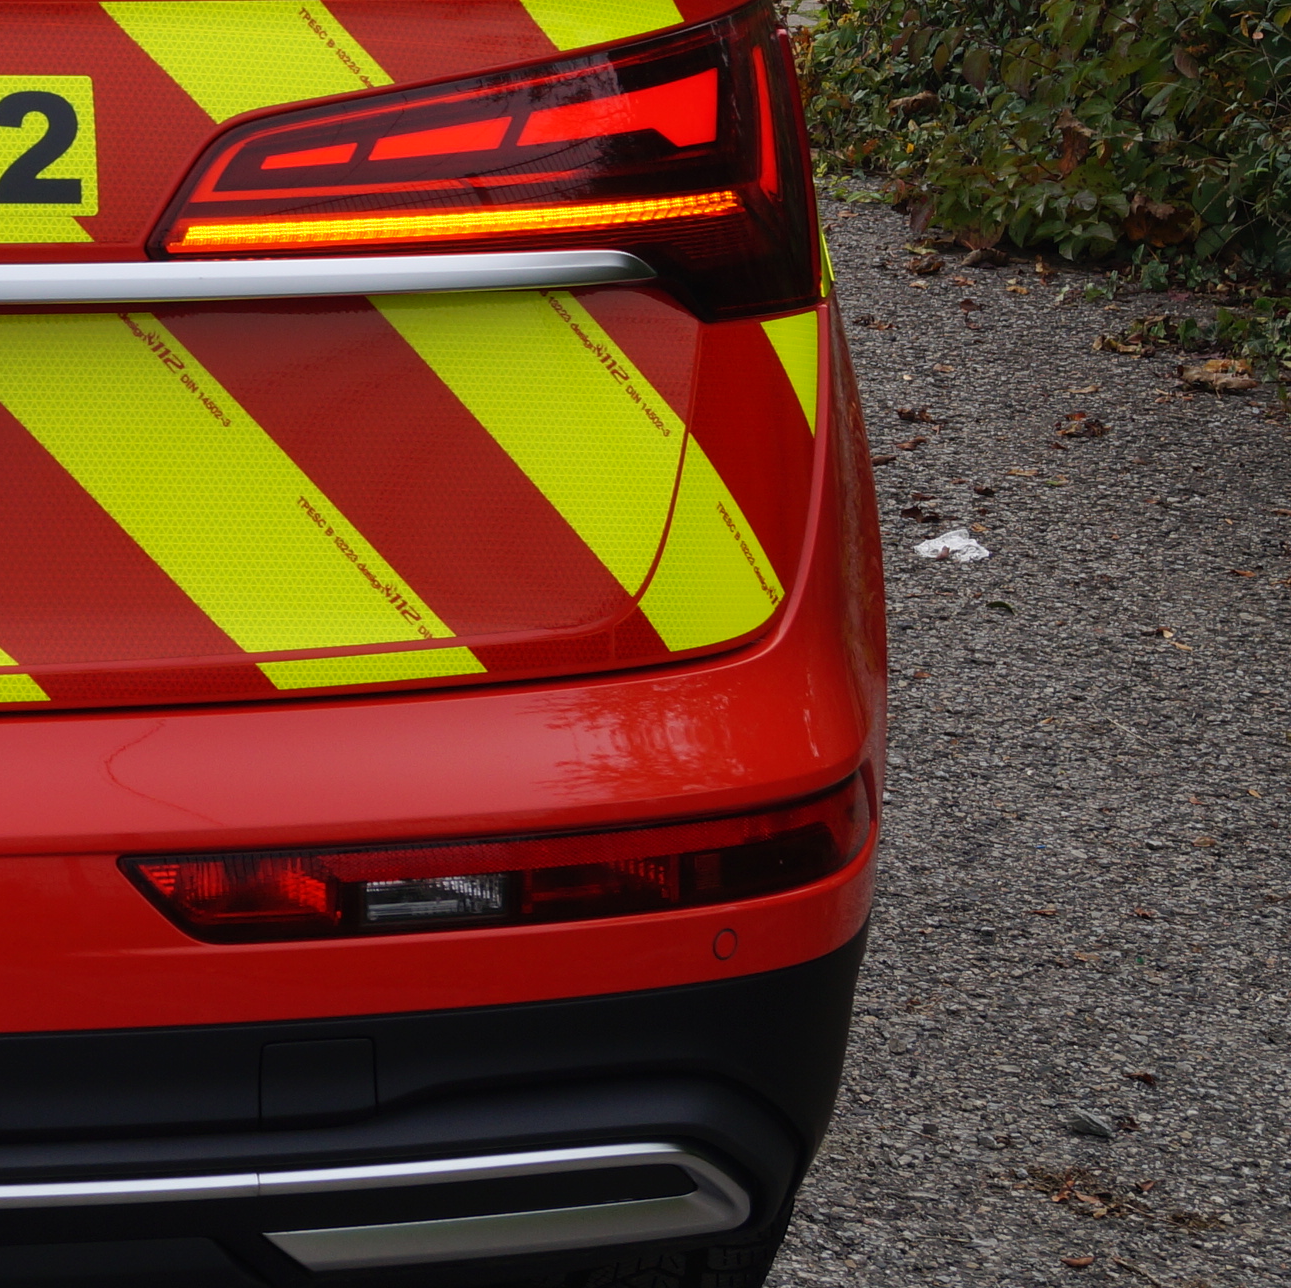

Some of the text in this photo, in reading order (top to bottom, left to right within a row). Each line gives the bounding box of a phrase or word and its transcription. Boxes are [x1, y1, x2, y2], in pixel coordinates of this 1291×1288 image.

[180, 374, 200, 394] DIN
[198, 392, 232, 428] 14502-3
[297, 495, 327, 529] TPESC
[324, 526, 335, 537] B
[333, 536, 359, 563] 13223
